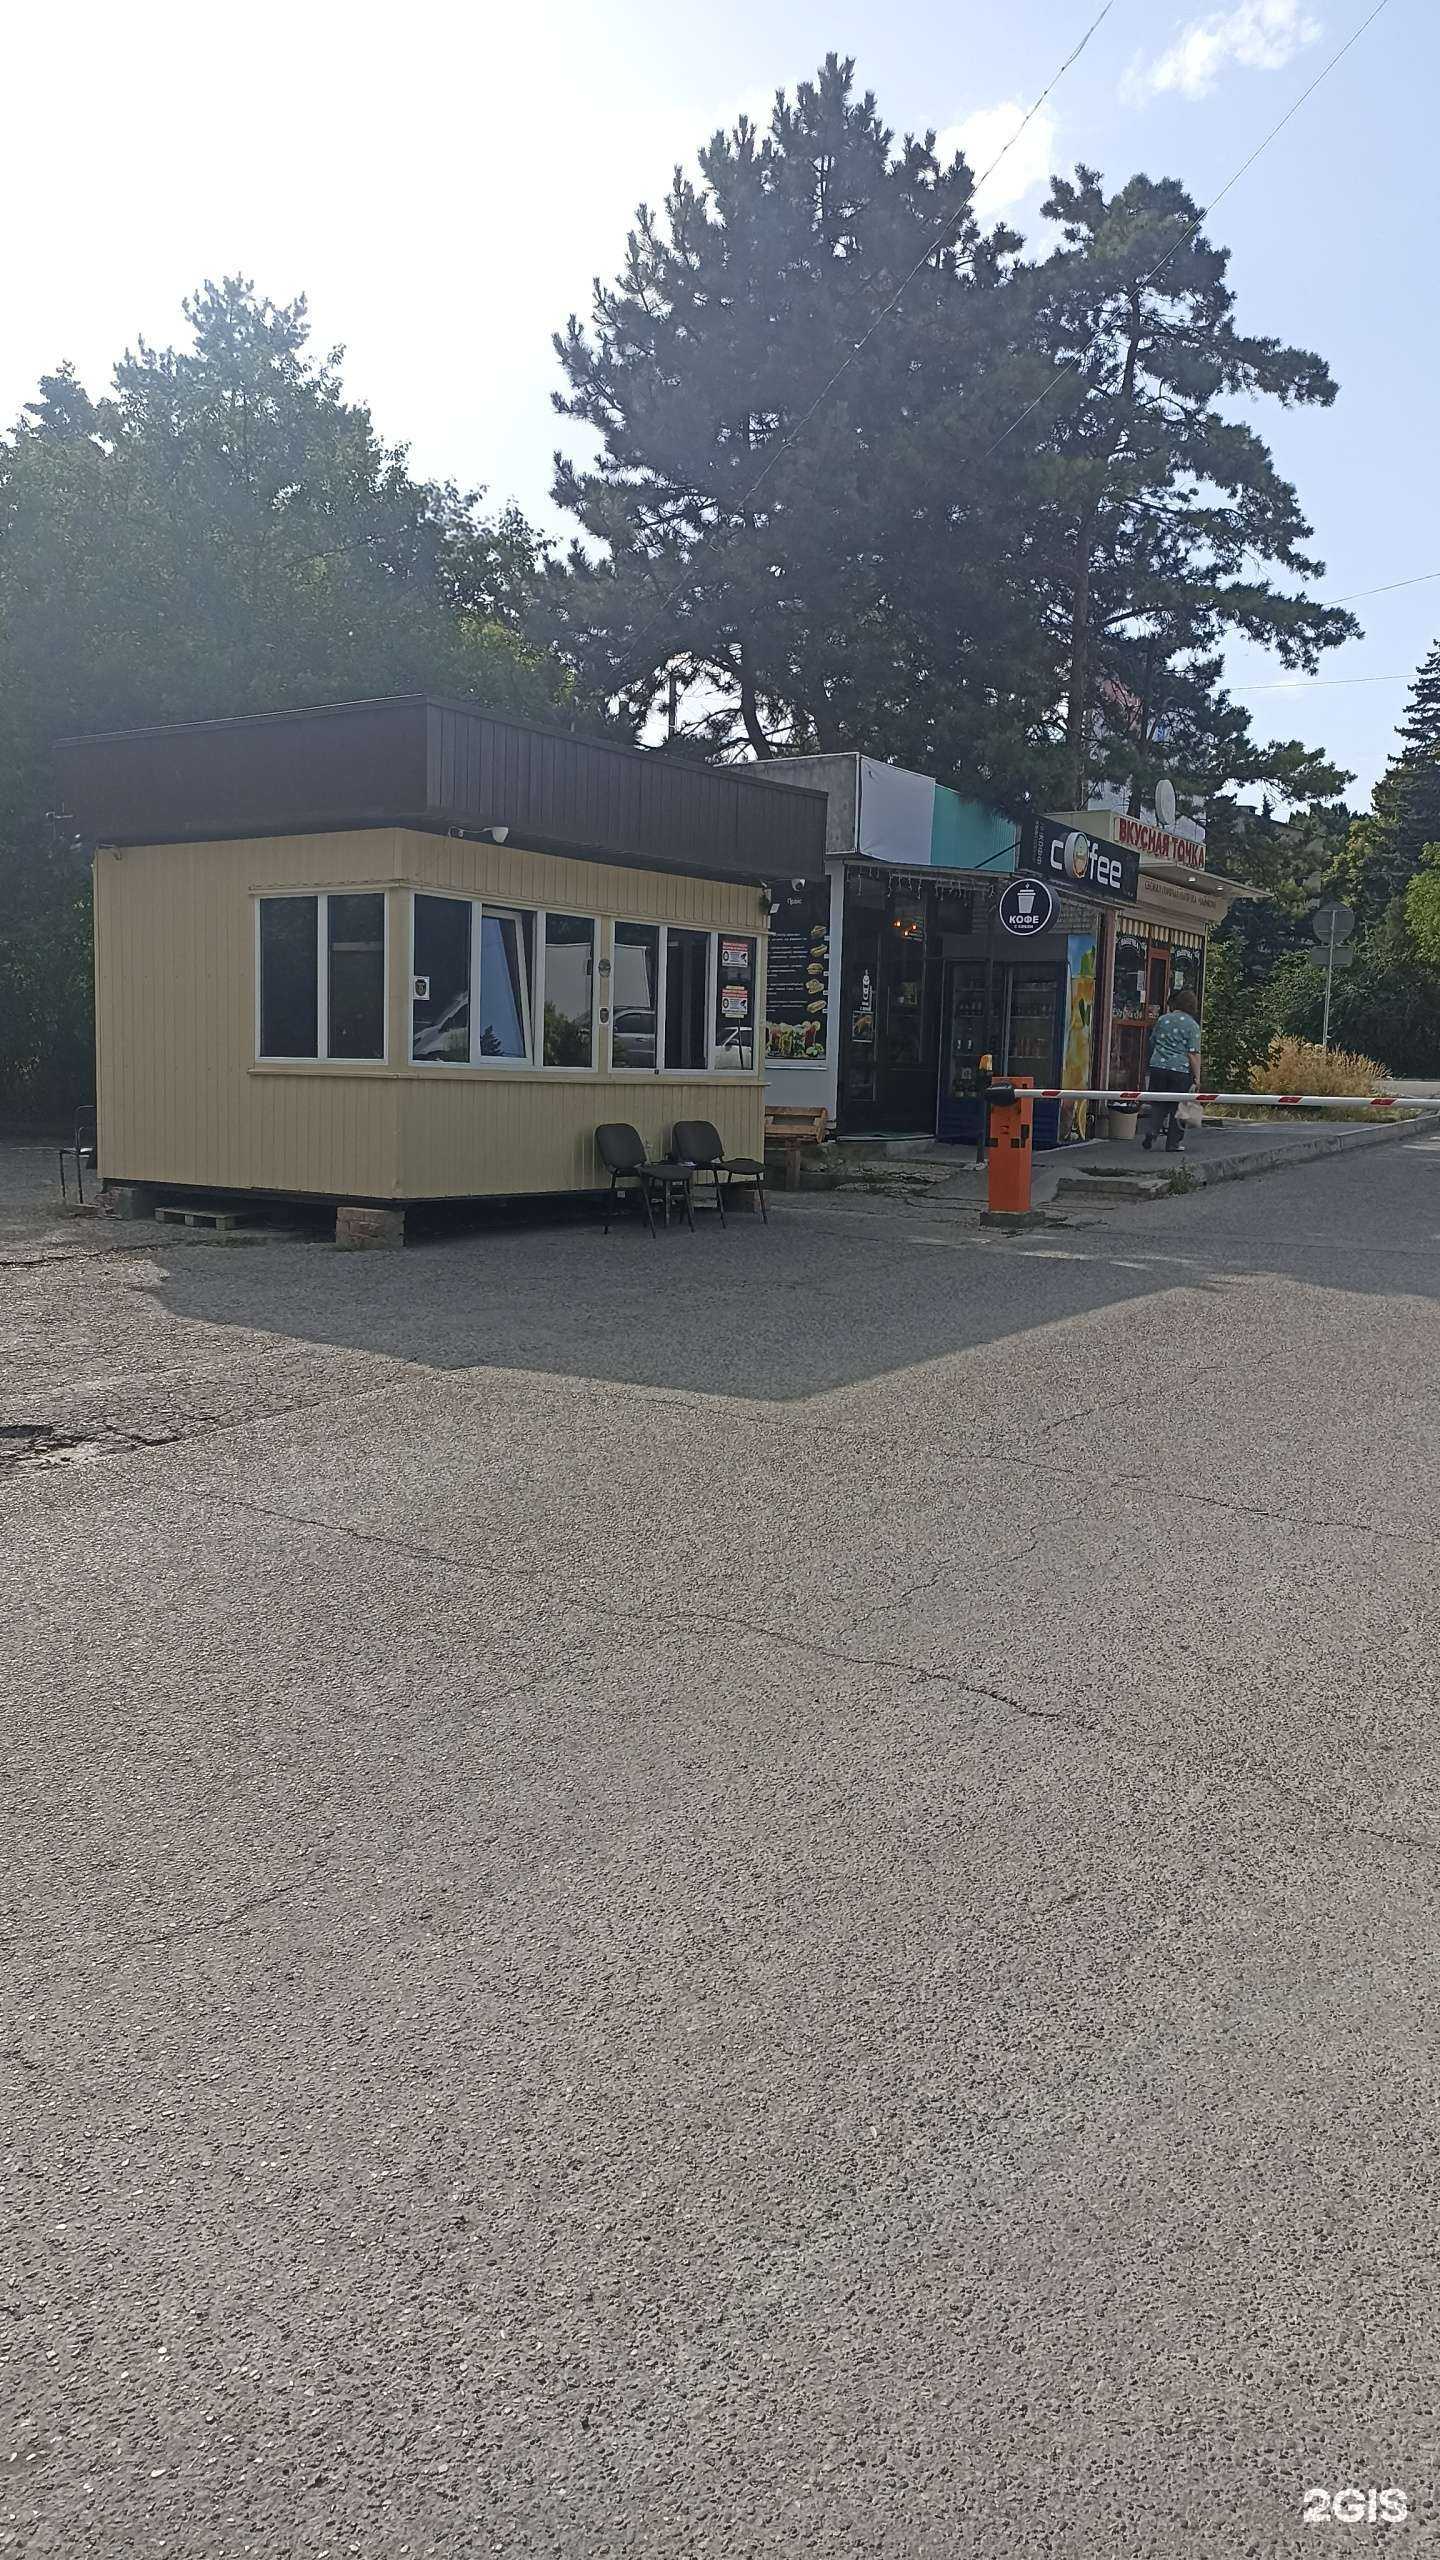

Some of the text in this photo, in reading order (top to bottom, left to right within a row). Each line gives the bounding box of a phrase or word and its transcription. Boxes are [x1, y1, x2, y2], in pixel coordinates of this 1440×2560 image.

[1050, 831, 1122, 889] cofee
[1119, 818, 1205, 865] ВКУСНАЯ ТОЧКА
[1009, 915, 1039, 924] КОФЕ
